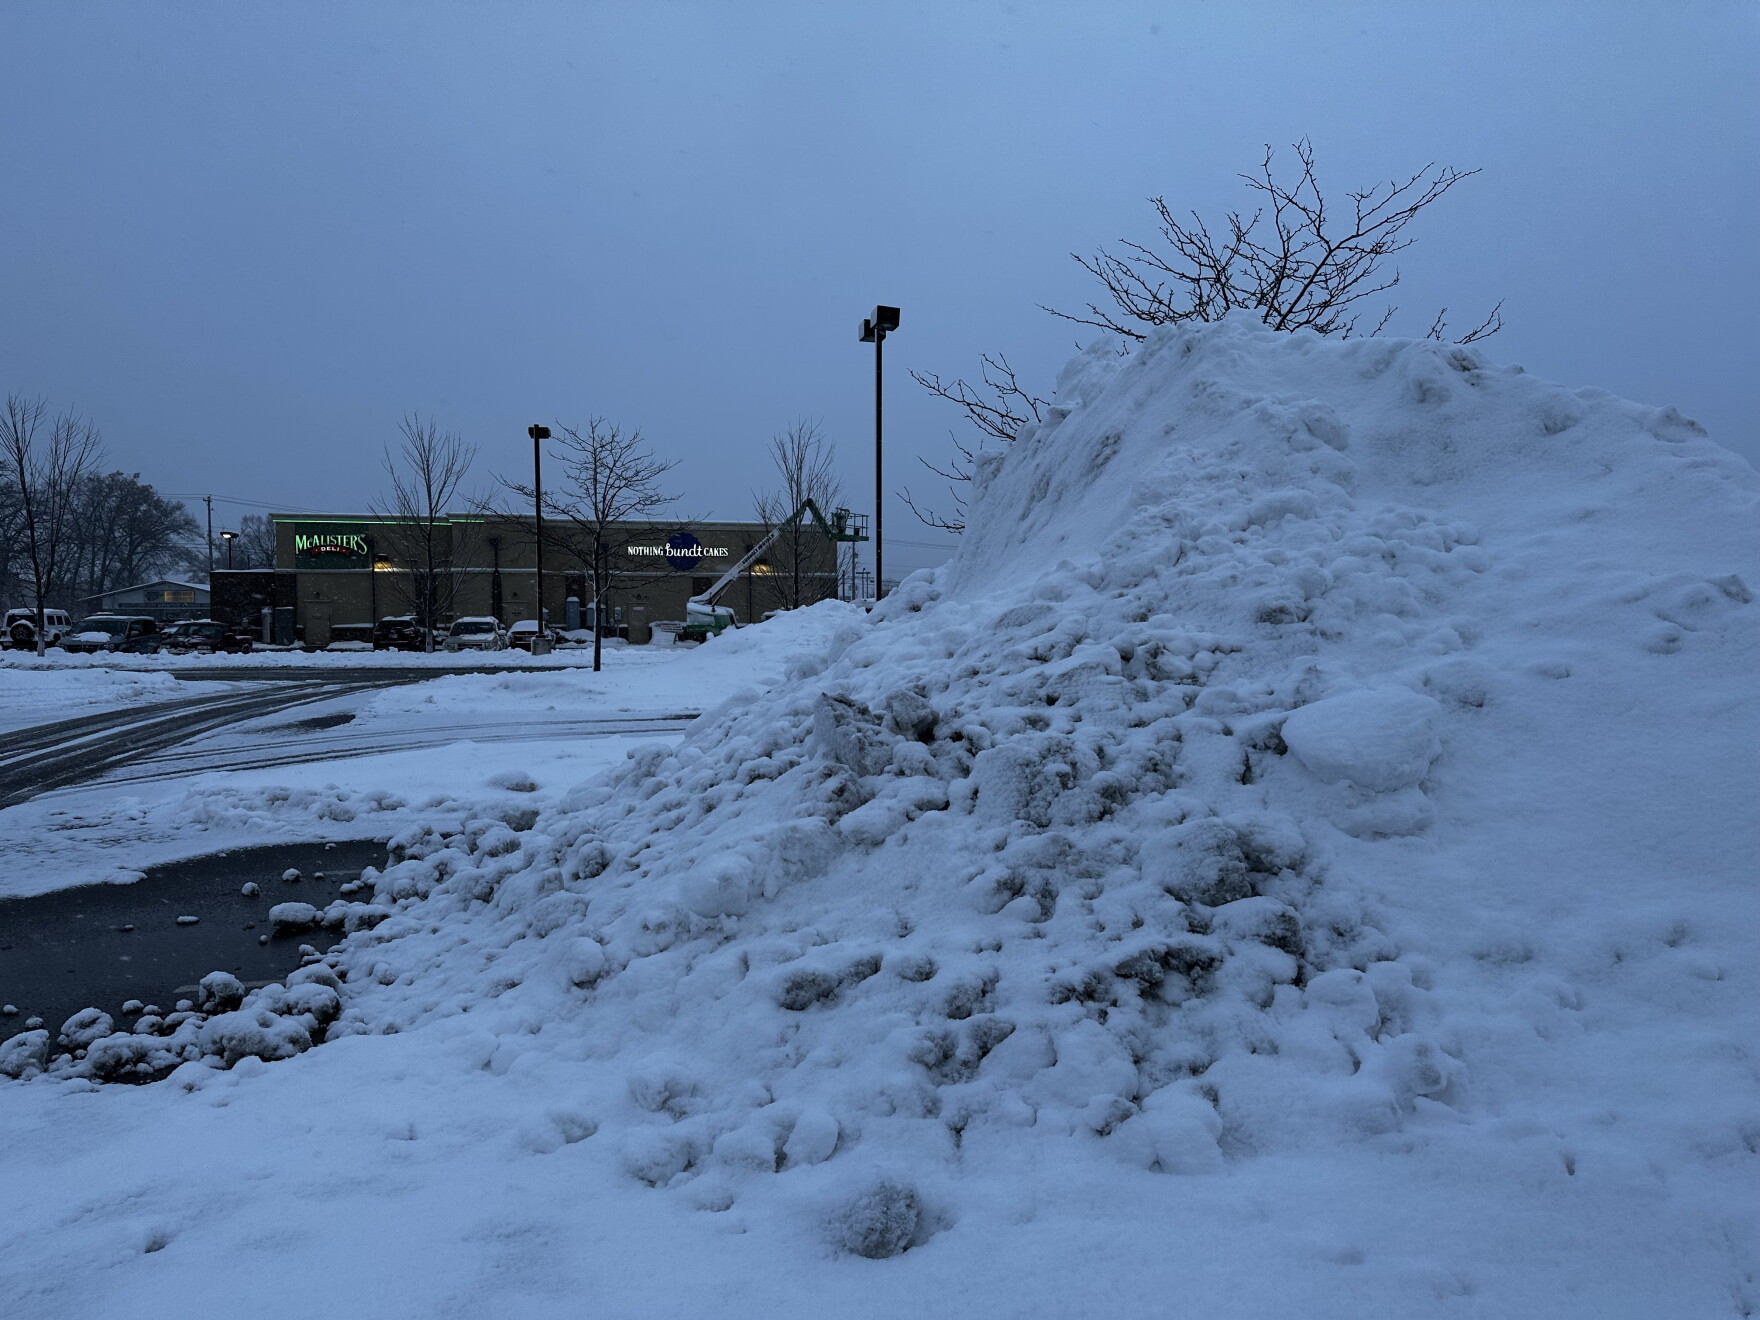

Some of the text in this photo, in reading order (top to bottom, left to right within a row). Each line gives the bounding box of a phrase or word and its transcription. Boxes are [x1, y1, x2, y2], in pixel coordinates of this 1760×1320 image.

[627, 542, 729, 557] NOTHING bundt CAKES
